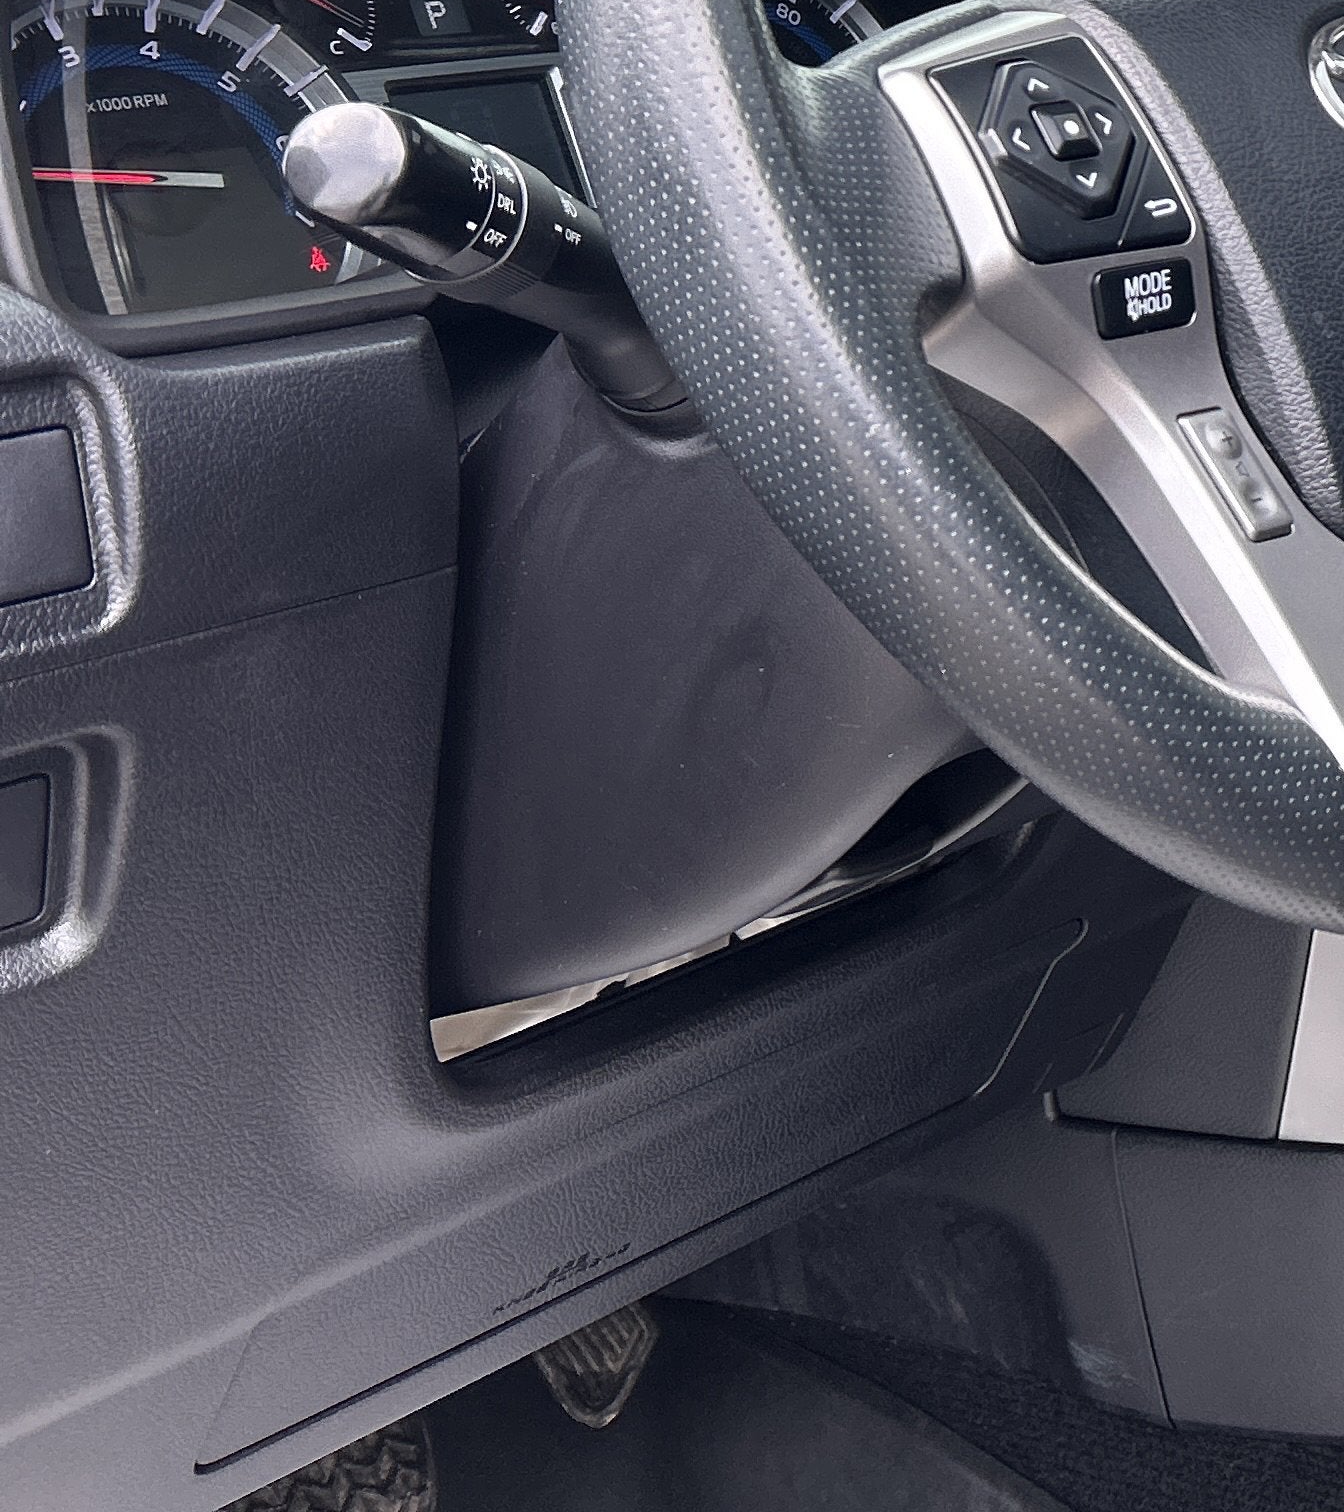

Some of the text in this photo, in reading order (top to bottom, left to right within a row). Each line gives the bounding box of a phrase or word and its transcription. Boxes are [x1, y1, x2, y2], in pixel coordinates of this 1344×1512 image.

[424, 0, 447, 30] P
[776, 2, 801, 26] 80
[57, 45, 81, 68] 3
[139, 40, 161, 60] 4
[329, 40, 344, 55] C
[217, 70, 241, 93] 5
[133, 92, 169, 107] RPM
[497, 192, 517, 215] DRL
[483, 227, 508, 248] OFF
[565, 228, 582, 246] OFF
[1124, 269, 1172, 300] MODE
[1138, 292, 1172, 317] HOLD
